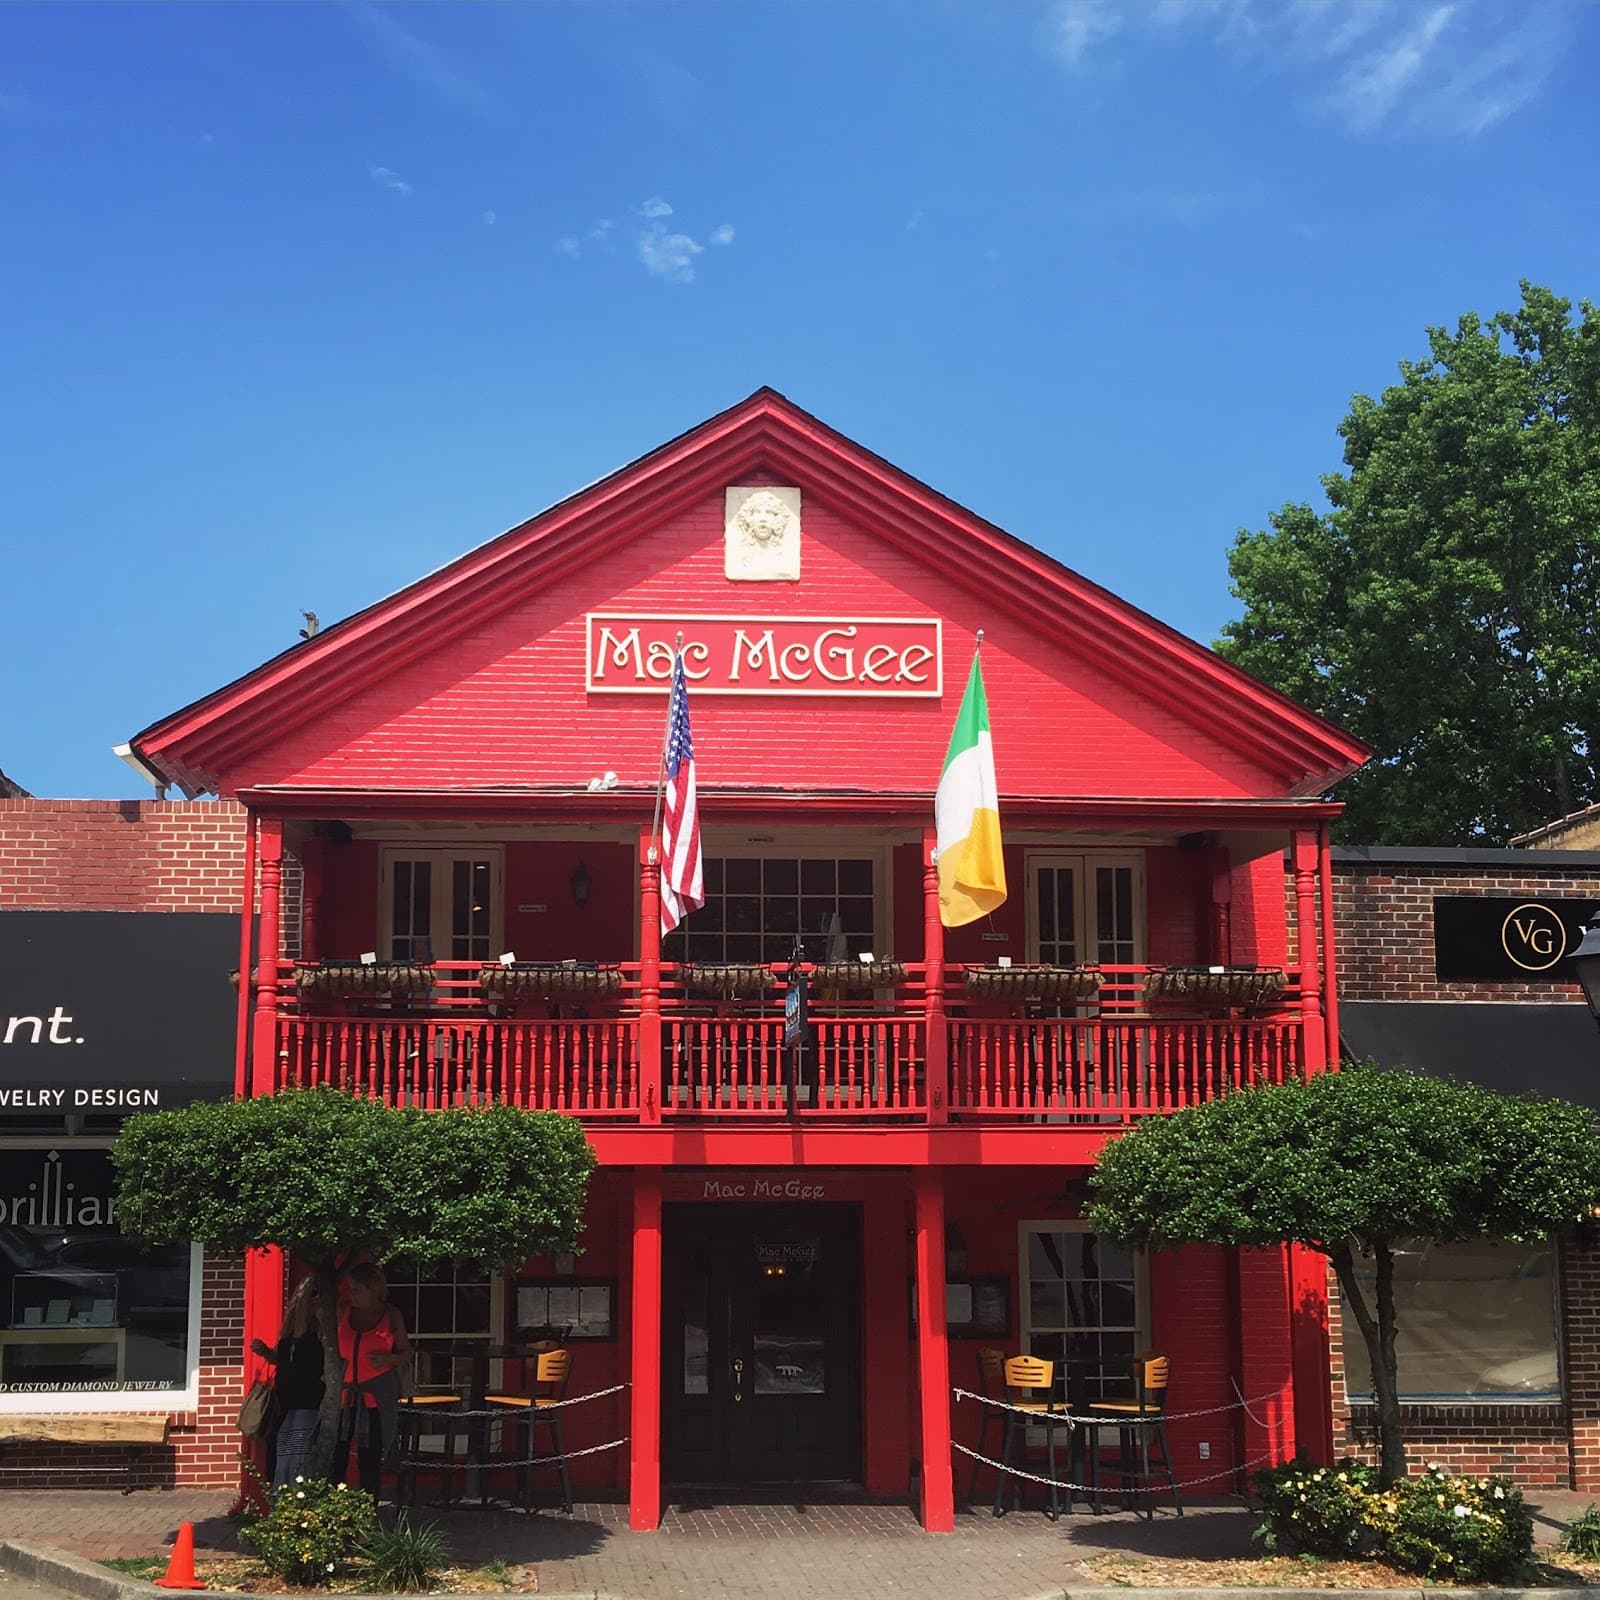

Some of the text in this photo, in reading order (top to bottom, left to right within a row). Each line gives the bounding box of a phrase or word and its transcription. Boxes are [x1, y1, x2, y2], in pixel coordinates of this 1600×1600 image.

[593, 625, 934, 683] Mac McGee
[1513, 918, 1553, 954] VG
[3, 1006, 85, 1044] nt.
[74, 1088, 159, 1106] DESIGN
[703, 1179, 825, 1199] Mac McGee
[10, 1382, 61, 1392] CUSTOM
[61, 1381, 119, 1392] DIAMOND
[121, 1380, 174, 1392] JEWELRY
